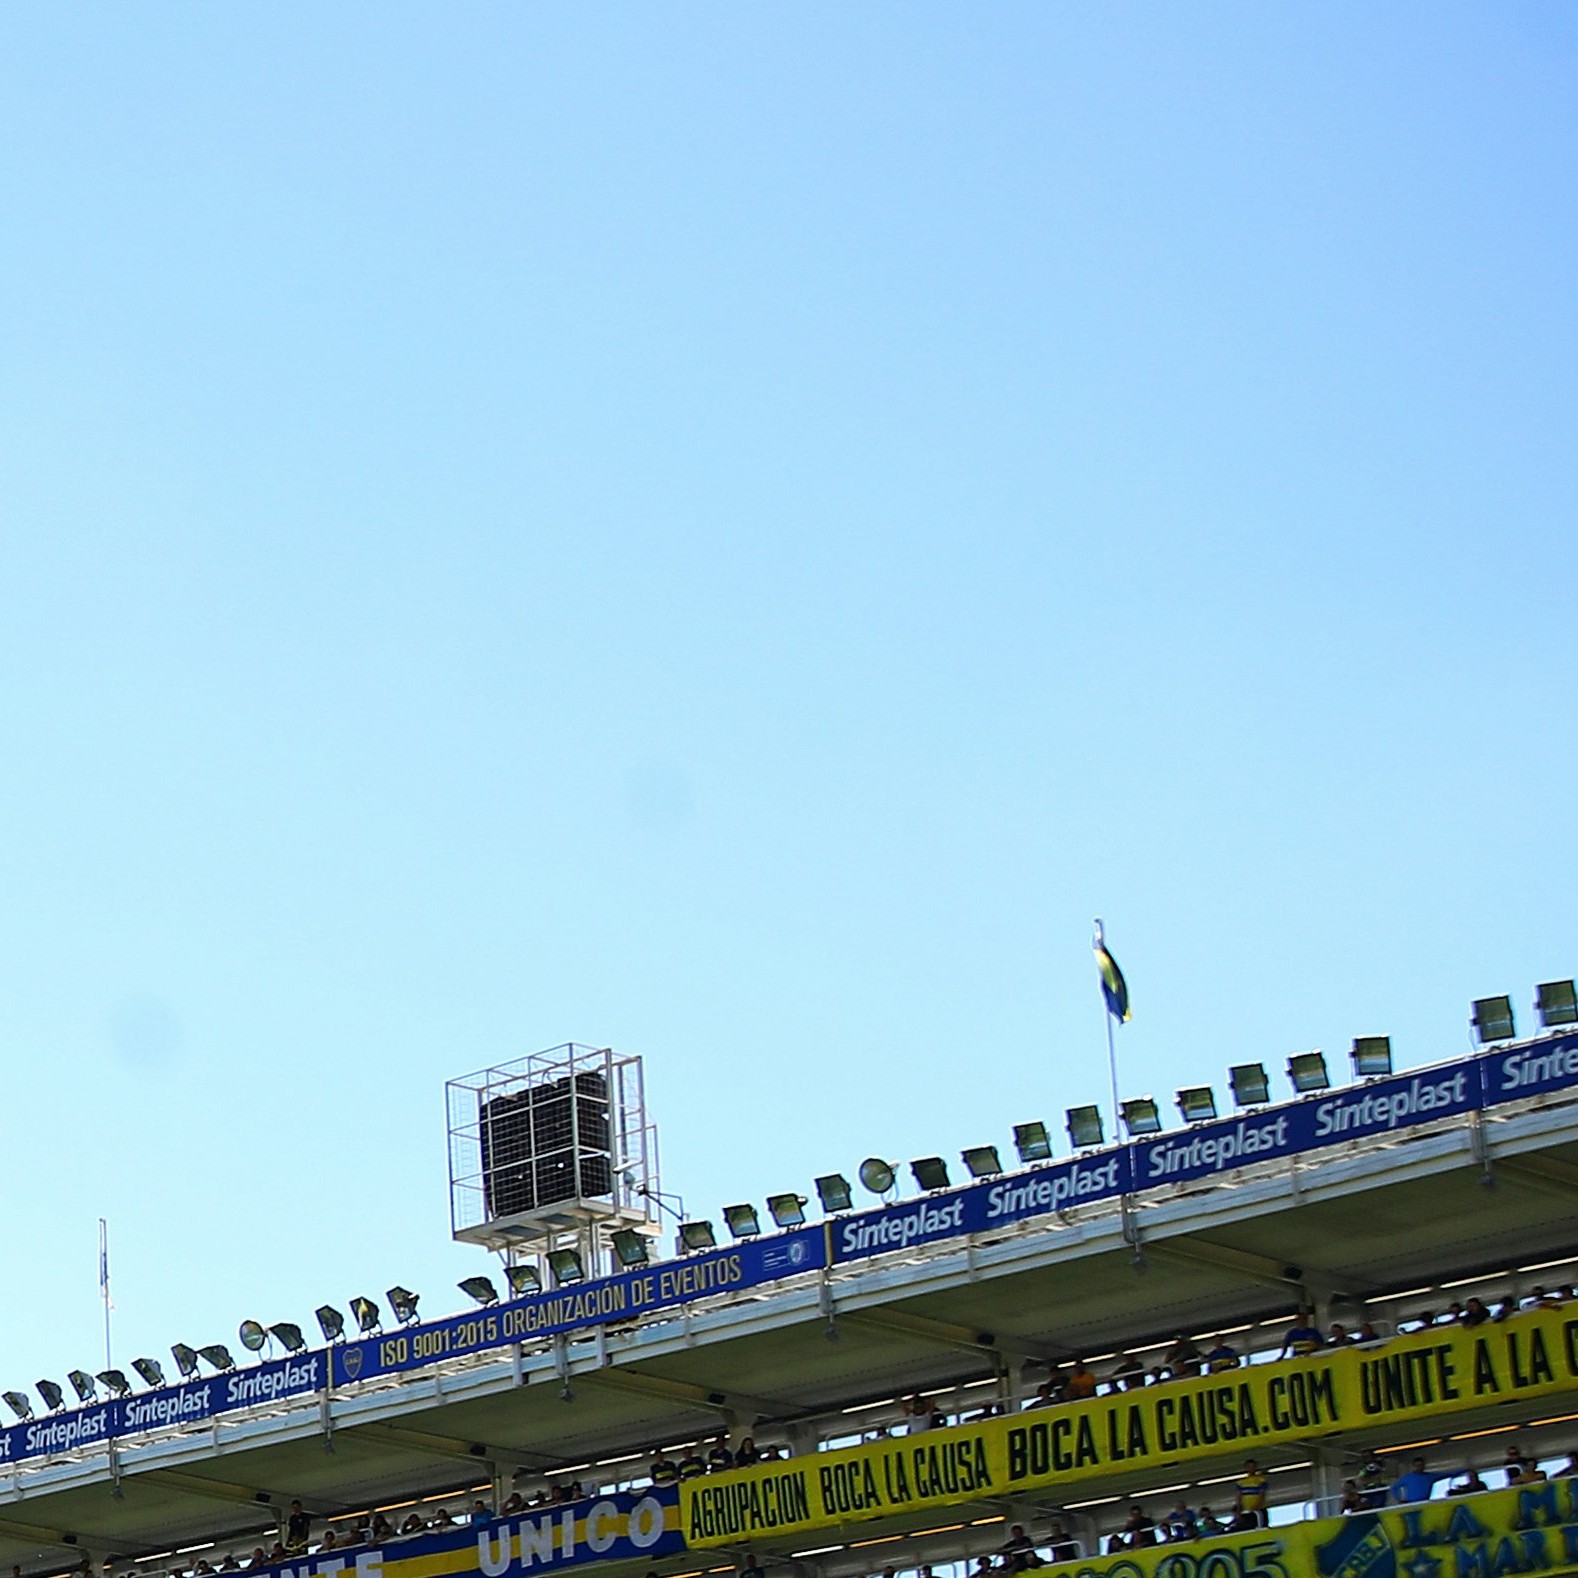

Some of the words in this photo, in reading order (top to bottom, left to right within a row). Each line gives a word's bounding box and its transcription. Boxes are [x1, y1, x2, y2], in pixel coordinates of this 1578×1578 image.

[1315, 1070, 1467, 1138] Sinteplast
[1147, 1114, 1288, 1179] Sinteplast
[986, 1156, 1120, 1219] Sinteplast
[841, 1197, 965, 1255] Sinteplast
[379, 1340, 408, 1368] ISO
[413, 1316, 497, 1360] 9001:2015
[502, 1281, 625, 1334] ORGANIZACIÓN
[630, 1278, 655, 1308] DE
[660, 1254, 742, 1297] EVENTOS
[124, 1385, 211, 1429] Sinteplast
[226, 1358, 318, 1403] Sinteplast
[1008, 1414, 1100, 1482] BOCA
[1107, 1403, 1148, 1462] LA
[1155, 1367, 1340, 1452] CAUSA.COM
[1359, 1342, 1458, 1415] UNITE
[1473, 1337, 1499, 1396] A
[1506, 1327, 1555, 1389] LA
[25, 1410, 107, 1451] Sinteplast
[689, 1469, 810, 1540] AGRUPACION
[819, 1457, 878, 1515] BOCA
[882, 1449, 913, 1503] LA
[913, 1438, 991, 1500] CAUSA
[476, 1496, 665, 1578] UNICO
